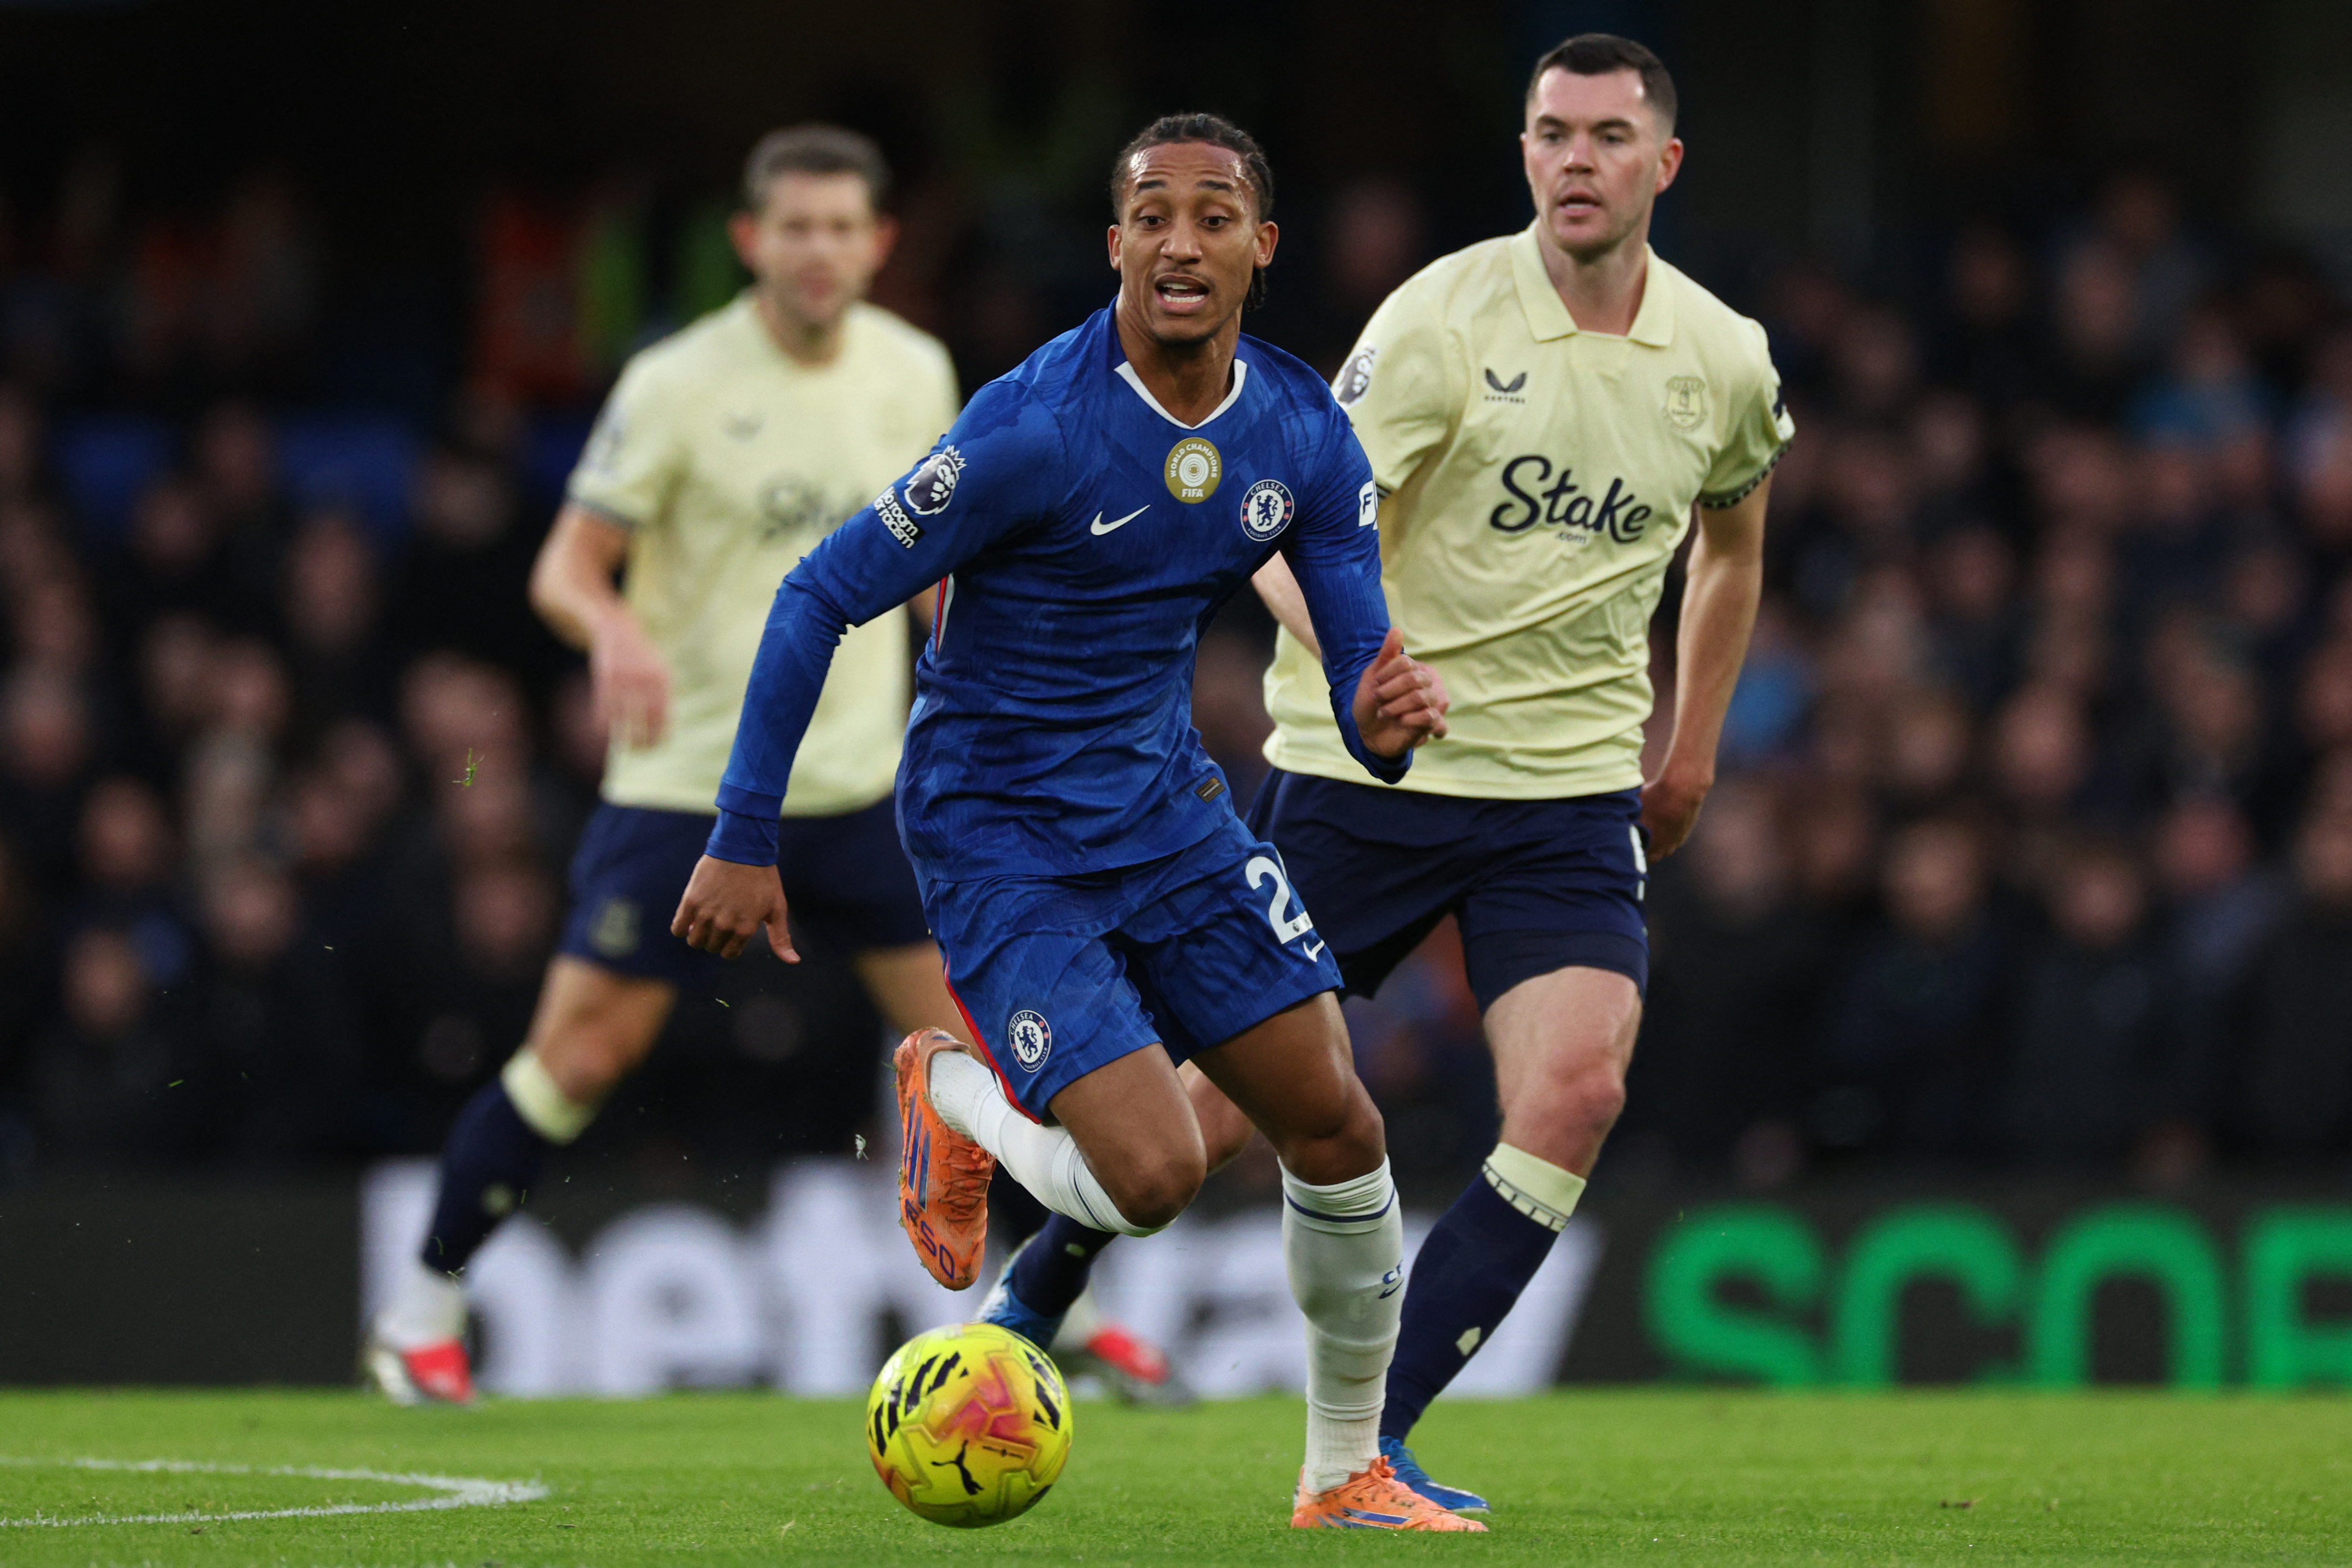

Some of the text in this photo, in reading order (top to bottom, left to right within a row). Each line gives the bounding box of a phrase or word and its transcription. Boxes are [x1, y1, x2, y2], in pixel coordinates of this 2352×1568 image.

[1170, 443, 1218, 478] WORLD CHAMPIONS
[1182, 488, 1204, 497] FIFA
[1250, 482, 1285, 496] CHELSEA
[1490, 454, 1652, 544] Stake
[878, 508, 915, 549] racism
[887, 501, 919, 537] room
[1245, 848, 1313, 945] 2
[1010, 1013, 1033, 1035] CHELSEA
